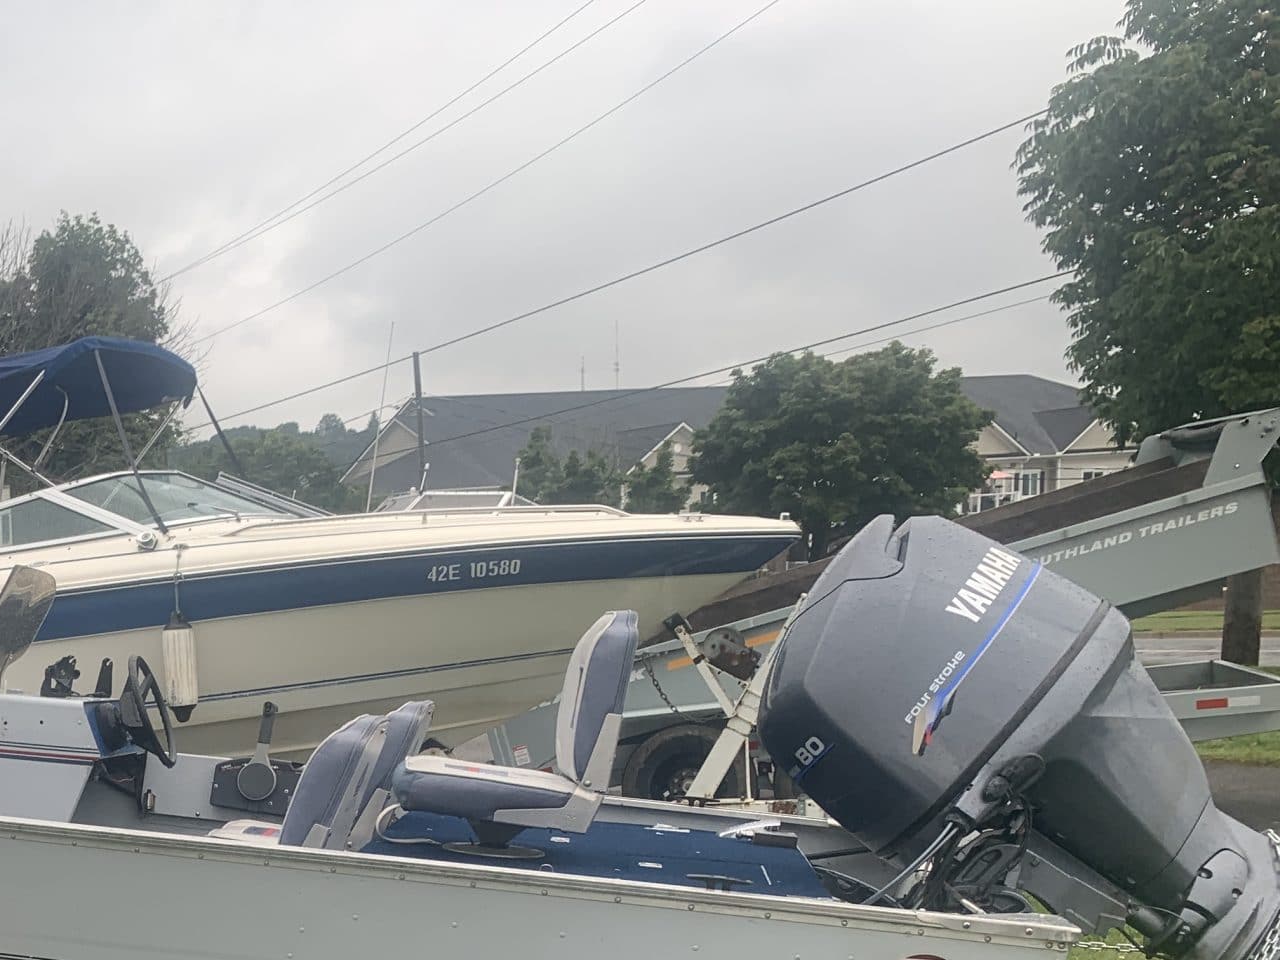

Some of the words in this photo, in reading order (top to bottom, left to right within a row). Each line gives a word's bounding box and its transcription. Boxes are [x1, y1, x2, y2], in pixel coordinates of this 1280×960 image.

[1034, 531, 1133, 566] UTHLAND
[1138, 501, 1239, 538] TRAILERS
[427, 563, 462, 582] 42E
[470, 559, 521, 578] 10580
[945, 547, 1022, 623] YAMAHA
